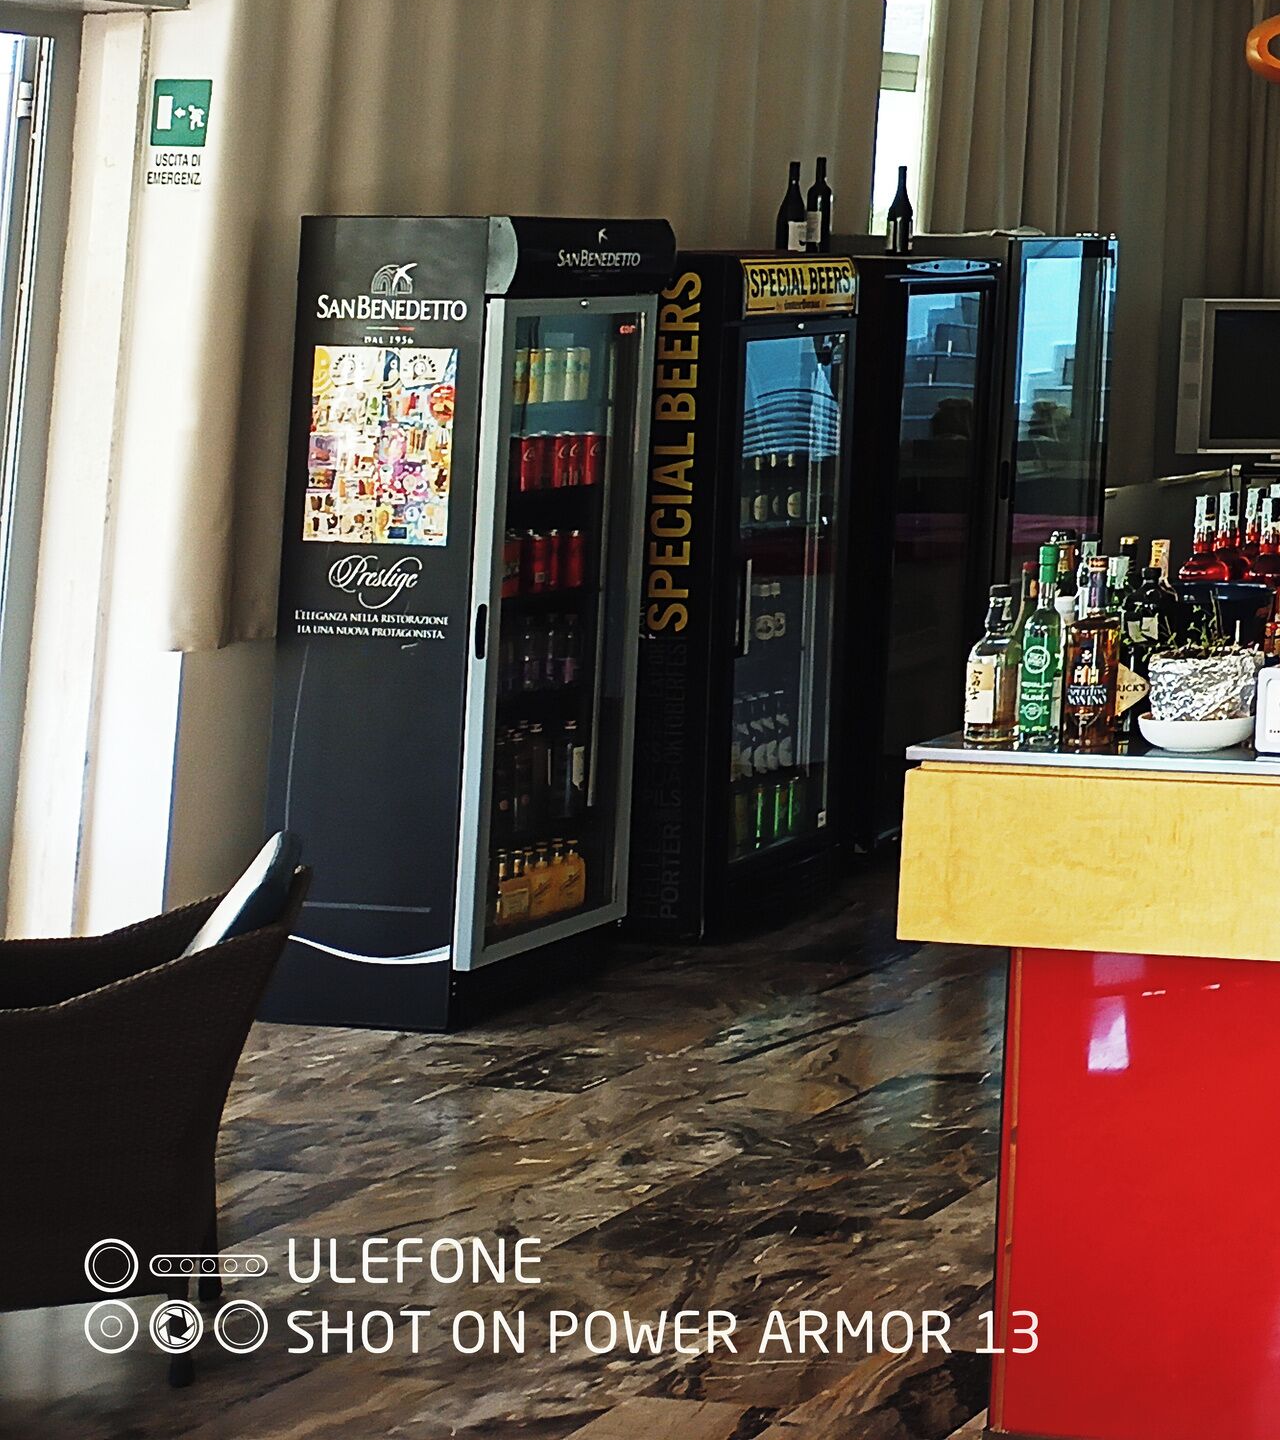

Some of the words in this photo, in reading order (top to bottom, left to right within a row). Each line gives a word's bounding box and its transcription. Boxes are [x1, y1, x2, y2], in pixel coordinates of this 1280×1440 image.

[155, 153, 188, 167] USCITA
[191, 154, 201, 167] DI
[147, 171, 202, 185] EMERGENZ
[750, 267, 807, 298] SPECIAL
[808, 265, 851, 295] BEERS
[364, 336, 384, 344] DAL
[654, 271, 703, 421] BEERS
[647, 432, 695, 632] SPECIAL
[328, 554, 423, 609] Prestige
[350, 613, 379, 623] NELLA
[381, 614, 449, 626] RISTORAZIONE
[313, 625, 334, 635] UNA
[336, 626, 369, 637] NUOVA
[1117, 683, 1146, 693] RICK'S
